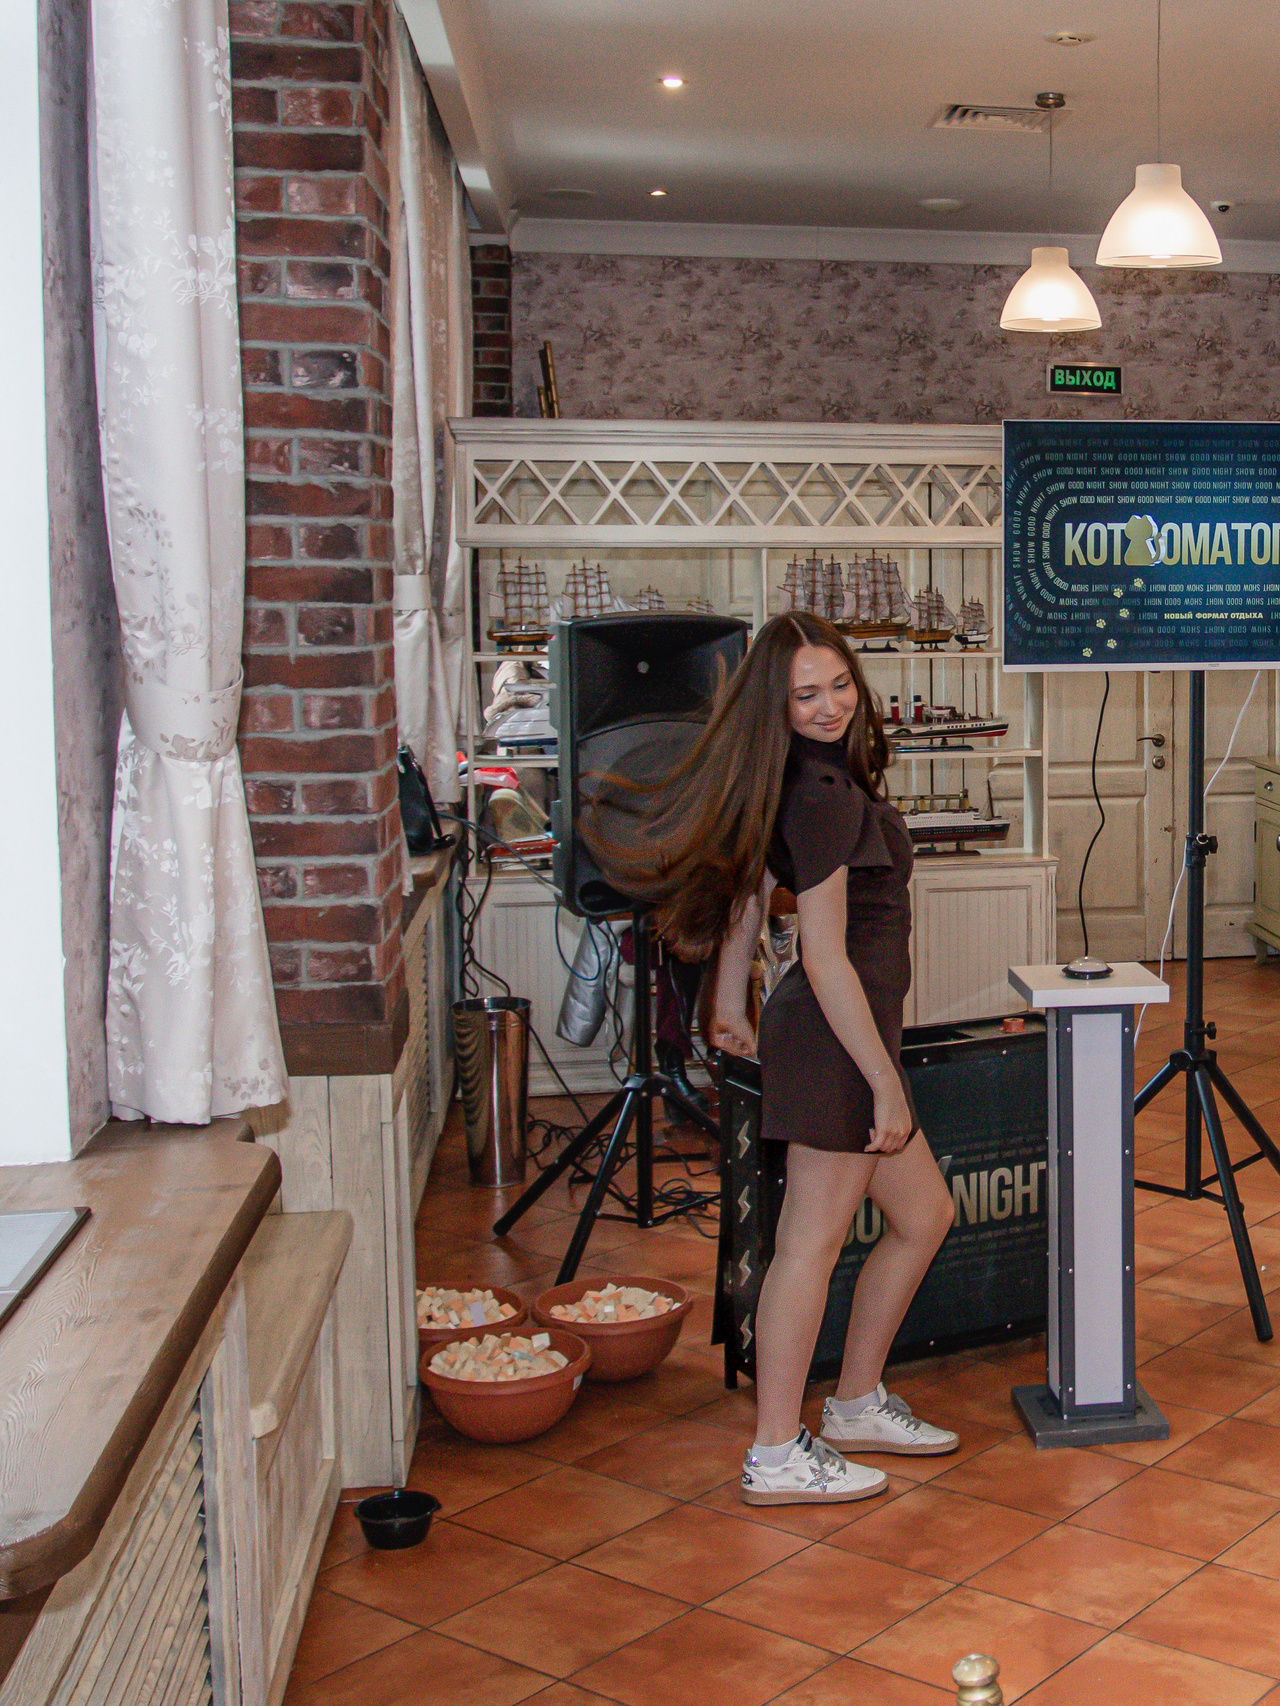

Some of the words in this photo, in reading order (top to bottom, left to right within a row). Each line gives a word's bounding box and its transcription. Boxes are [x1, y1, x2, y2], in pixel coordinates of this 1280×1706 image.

[1054, 369, 1117, 390] ВЫХОД
[1032, 468, 1053, 482] SHOW
[1056, 467, 1074, 475] GOOD
[1076, 467, 1097, 475] NIGHT
[1101, 467, 1120, 475] SHOW
[1124, 467, 1143, 475] GOOD
[1145, 467, 1165, 475] NIGHT
[1168, 467, 1188, 475] SHOW
[1192, 467, 1210, 475] GOOD
[1046, 481, 1065, 495] SHOW
[1068, 481, 1084, 489] GOOD
[1087, 481, 1105, 489] NIGHT
[1109, 481, 1128, 489] SHOW
[1131, 481, 1149, 489] GOOD
[1150, 481, 1169, 489] NIGHT
[1171, 481, 1191, 489] SHOW
[1193, 481, 1211, 489] GOOD
[1213, 481, 1231, 489] NIGHT
[1233, 481, 1253, 489] SHOW
[1255, 481, 1273, 489] GOOD
[1016, 480, 1032, 506] NIGHT
[1030, 492, 1046, 514] NIGHT
[1060, 496, 1077, 508] SHOW
[1080, 496, 1095, 504] GOOD
[1097, 496, 1114, 504] NIGHT
[1117, 496, 1135, 504] SHOW
[1137, 496, 1154, 504] GOOD
[1155, 496, 1173, 504] NIGHT
[1175, 496, 1193, 504] SHOW
[1195, 496, 1211, 504] GOOD
[1213, 496, 1230, 504] NIGHT
[1232, 496, 1250, 504] SHOW
[1252, 496, 1268, 504] GOOD
[1045, 504, 1060, 521] NIGHT
[1013, 510, 1021, 535] GOOD
[1028, 516, 1036, 537] GOOD
[1042, 522, 1051, 539] GOOD
[1028, 541, 1036, 563] SHOW
[1042, 540, 1050, 560] SHOW
[1013, 542, 1021, 569] SHOW
[1042, 561, 1056, 580] NIGHT
[1028, 568, 1042, 590] NIGHT
[1053, 577, 1069, 590] GOOD
[1013, 575, 1028, 601] NIGHT
[1071, 584, 1089, 592] SHOW
[1092, 584, 1109, 592] NIGHT
[1149, 584, 1166, 592] NIGHT
[1168, 584, 1184, 592] GOOD
[1186, 584, 1204, 592] SHOW
[1206, 584, 1224, 592] NIGHT
[1225, 584, 1241, 592] GOOD
[1243, 584, 1260, 592] SHOW
[1040, 588, 1057, 604] GOOD
[1059, 598, 1078, 606] SHOW
[1081, 598, 1100, 606] NIGHT
[1144, 598, 1162, 606] NIGHT
[1164, 598, 1182, 606] GOOD
[1184, 598, 1203, 606] SHOW
[1206, 598, 1224, 606] NIGHT
[1026, 600, 1044, 618] GOOD
[1047, 612, 1067, 620] SHOW
[1070, 612, 1090, 620] NIGHT
[1164, 611, 1193, 620] НОВЫЙ
[1195, 612, 1229, 620] ФОРМАТ
[1230, 612, 1264, 620] ОТДЫХА
[952, 1160, 1047, 1228] NIGH
